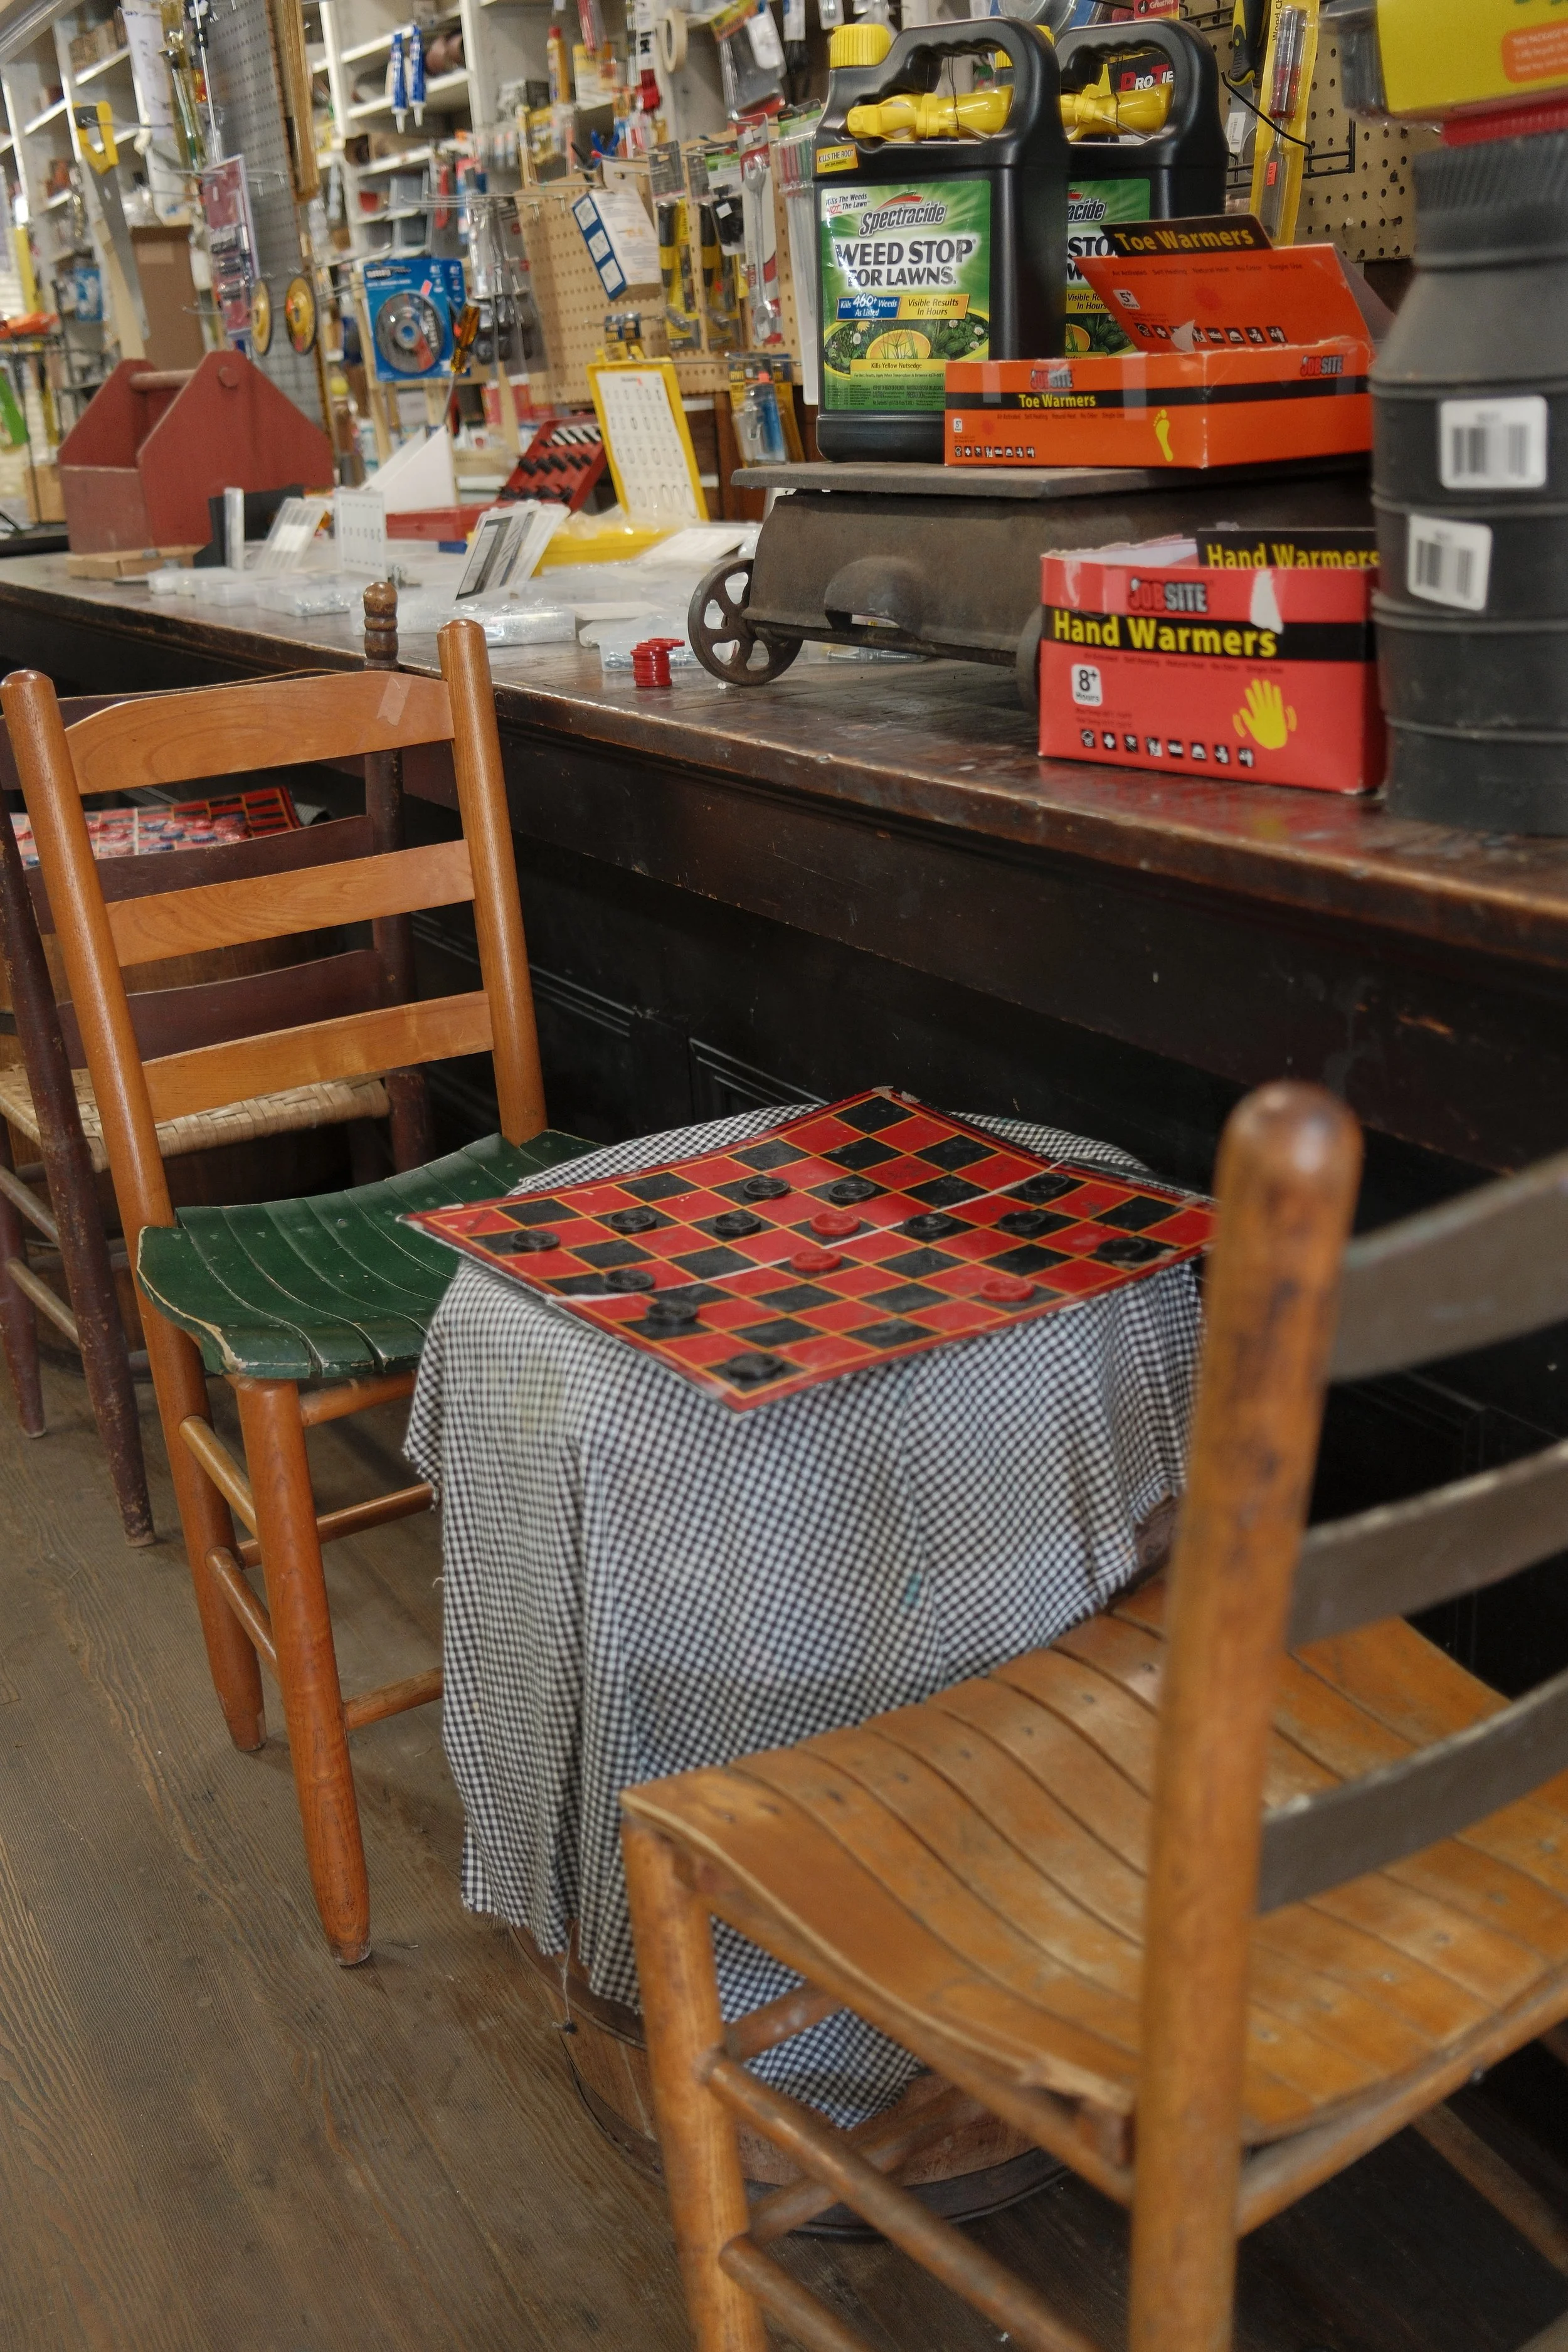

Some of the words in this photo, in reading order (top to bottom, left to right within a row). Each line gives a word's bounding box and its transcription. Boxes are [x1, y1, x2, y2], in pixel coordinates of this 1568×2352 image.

[818, 154, 830, 163] KILLS
[841, 149, 854, 158] ROOT
[826, 198, 837, 206] Kills
[859, 201, 947, 237] Spectracide
[1067, 235, 1114, 258] STO
[1114, 232, 1157, 251] Toe
[1155, 228, 1254, 250] Warmers
[835, 242, 904, 267] WEED
[848, 269, 882, 287] FOR
[840, 300, 851, 309] Kills
[878, 299, 897, 308] Weeds
[908, 299, 931, 307] Visible
[933, 298, 959, 307] Results
[1067, 293, 1089, 301] Visible
[855, 309, 862, 317] As
[863, 308, 879, 317] Listed
[926, 307, 948, 316] Hours
[1019, 394, 1040, 408] Toe
[1041, 393, 1096, 408] Warmers
[1205, 542, 1266, 569] Hand
[1271, 542, 1379, 569] Warmers
[1130, 577, 1209, 613] JOBSITE
[1053, 608, 1120, 648] Hand
[1126, 616, 1278, 659] Warmers
[1079, 669, 1098, 692] 8+
[1075, 692, 1100, 703] Hours
